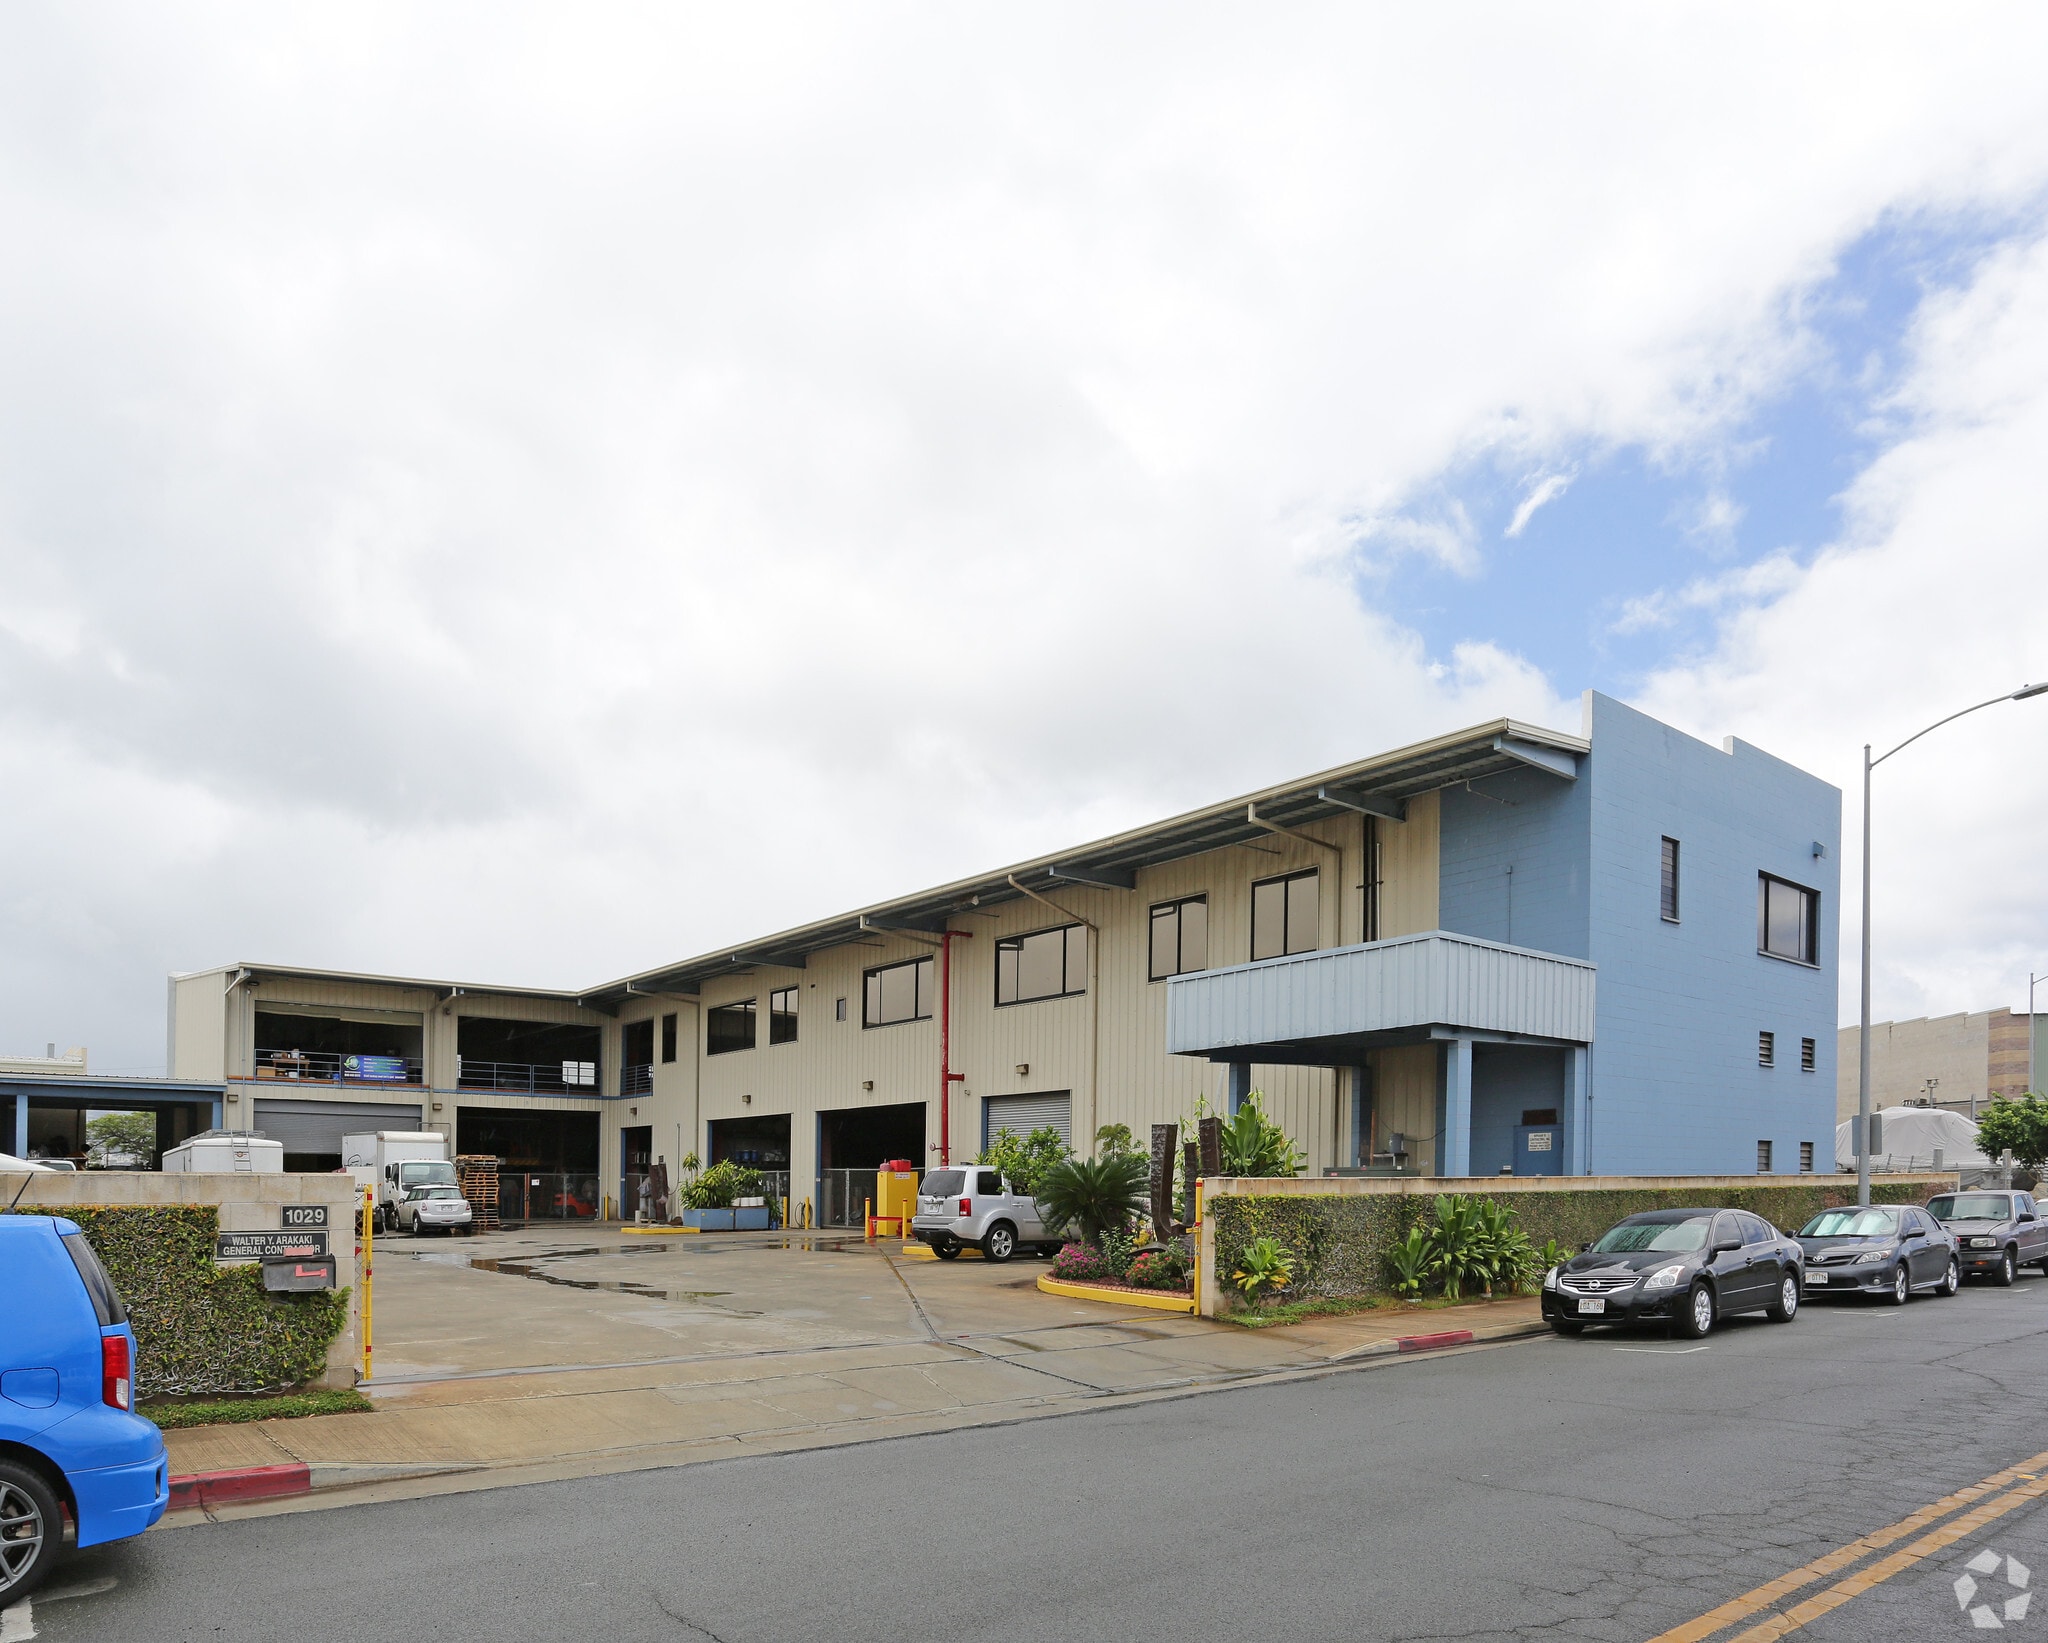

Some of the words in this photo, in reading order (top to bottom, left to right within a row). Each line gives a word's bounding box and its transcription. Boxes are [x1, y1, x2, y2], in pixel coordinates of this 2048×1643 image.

[286, 1209, 324, 1224] 1029
[232, 1236, 266, 1246] WALTER
[267, 1236, 275, 1245] Y.
[276, 1235, 313, 1245] ARAKAKI
[223, 1245, 264, 1256] GENERAL
[265, 1244, 321, 1255] CONOR
